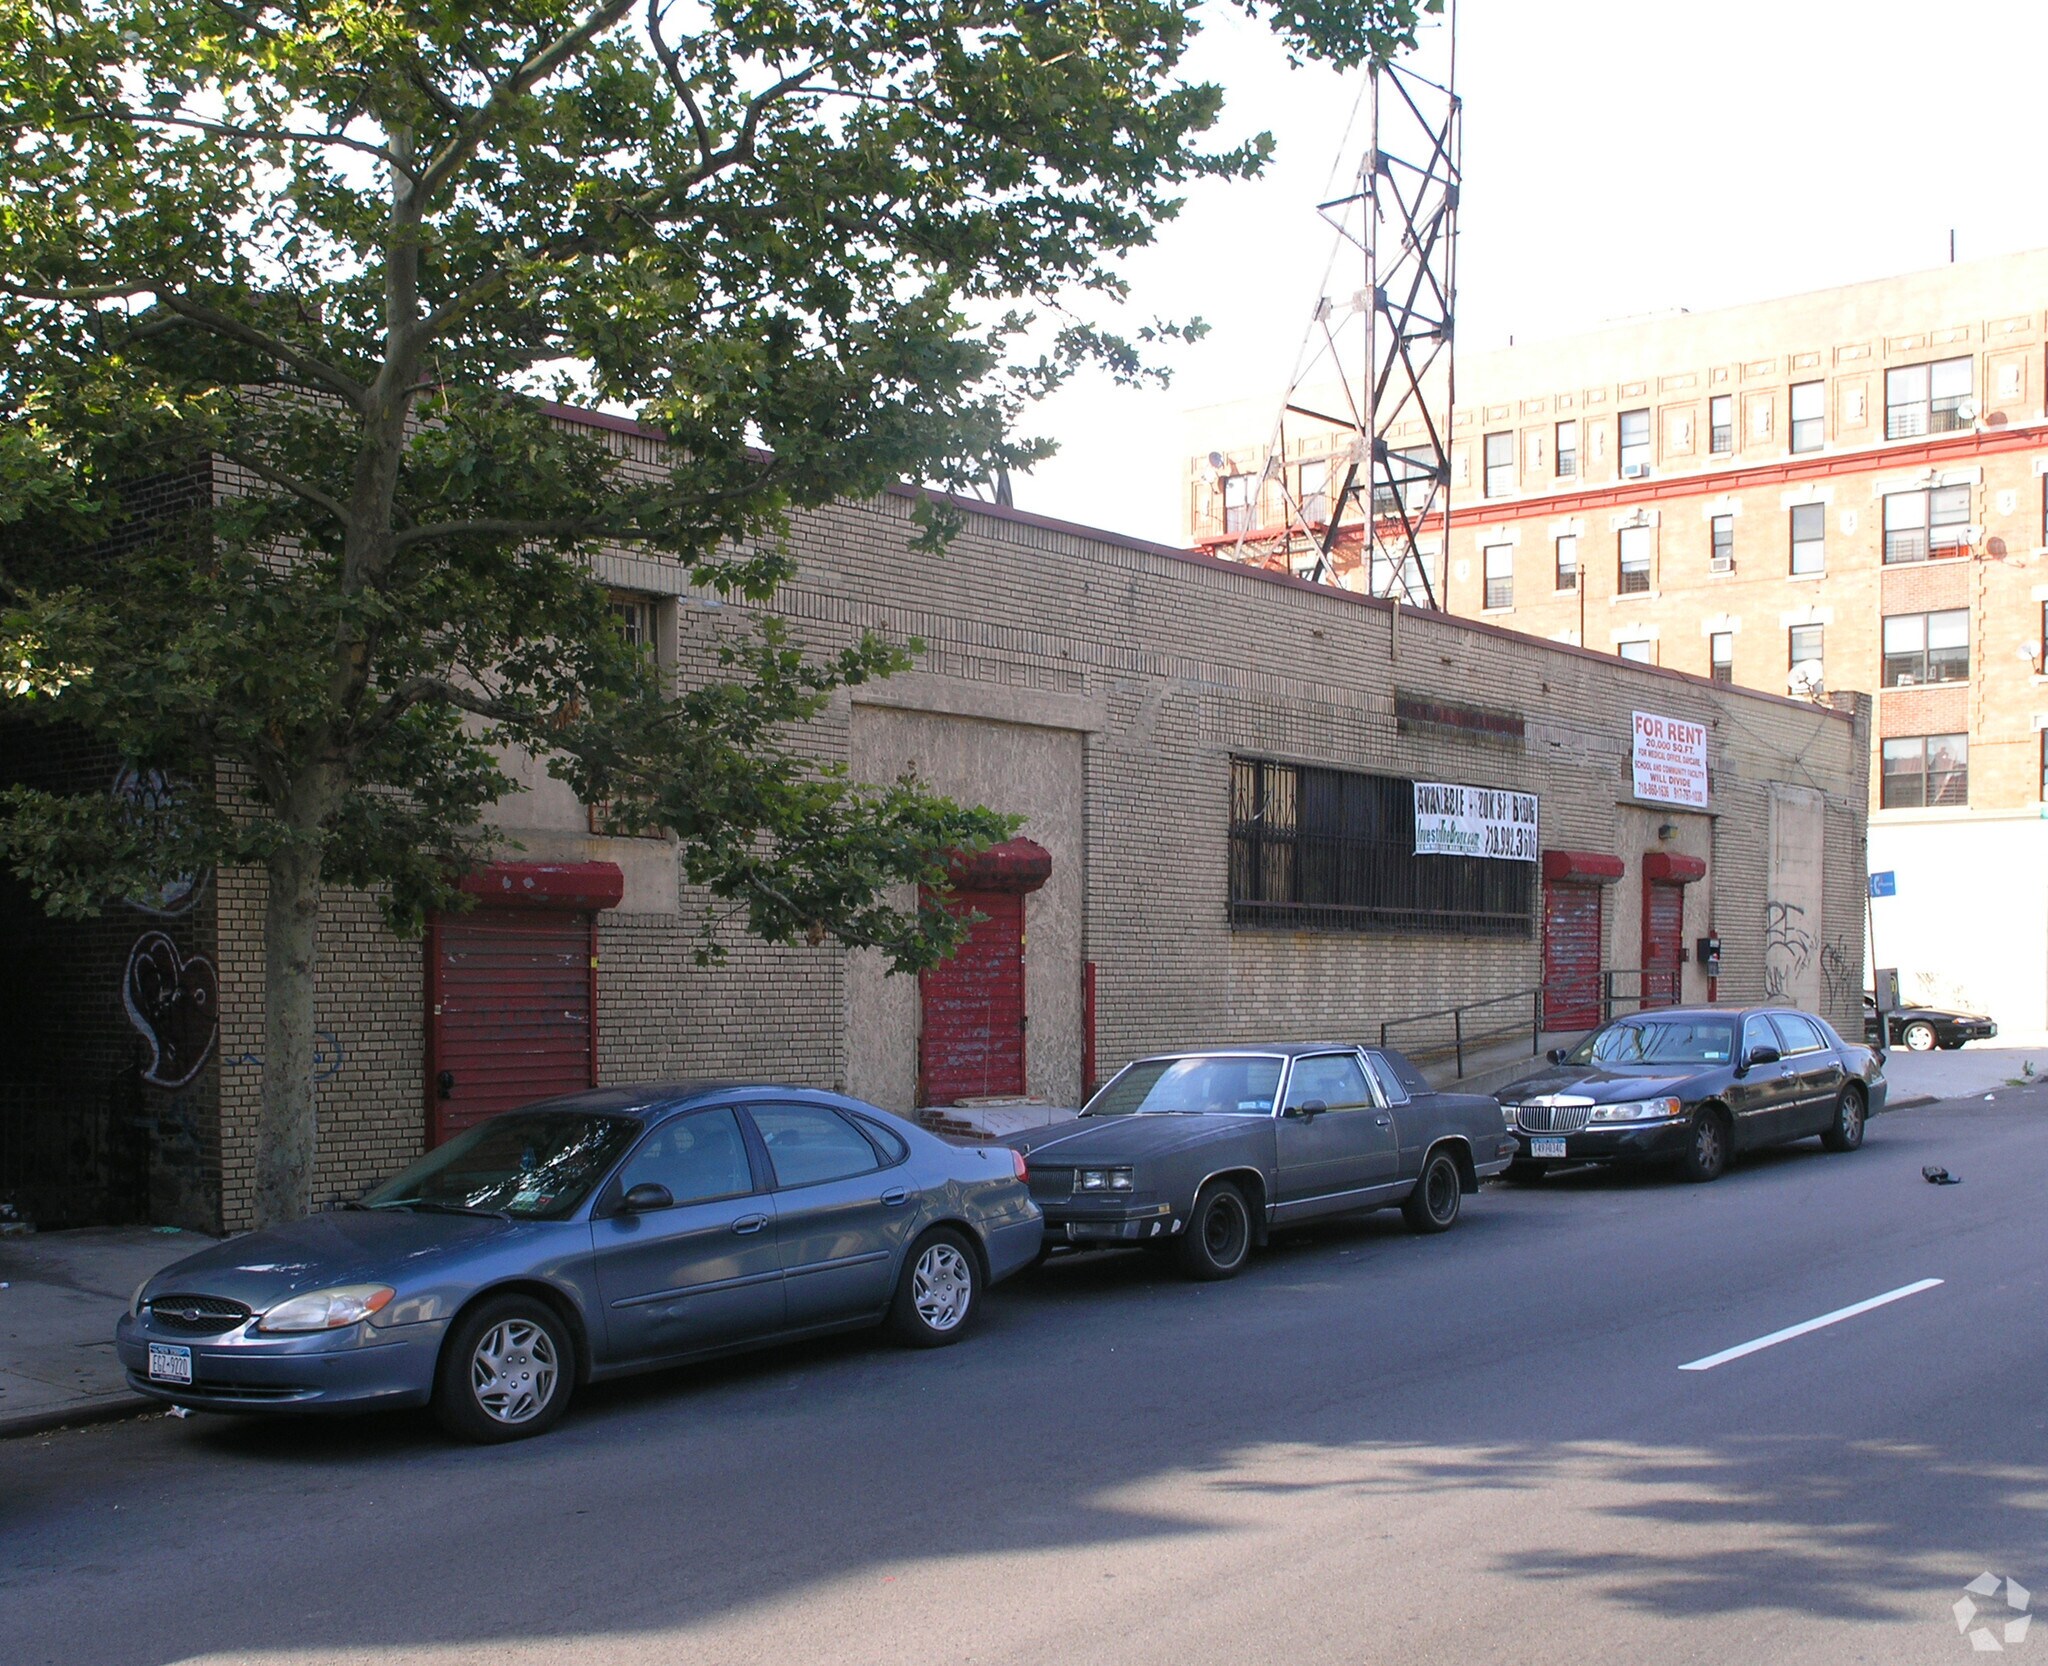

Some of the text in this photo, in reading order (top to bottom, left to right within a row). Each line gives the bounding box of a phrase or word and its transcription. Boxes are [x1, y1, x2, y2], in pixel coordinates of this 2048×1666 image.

[1635, 716, 1703, 746] FOR RENT
[1646, 738, 1670, 750] 20,000
[1648, 749, 1666, 761] MEDICAL
[1634, 760, 1652, 771] SCHOOL
[1650, 773, 1691, 787] WILL DIVIDE
[1417, 786, 1464, 817] AVAILABLE
